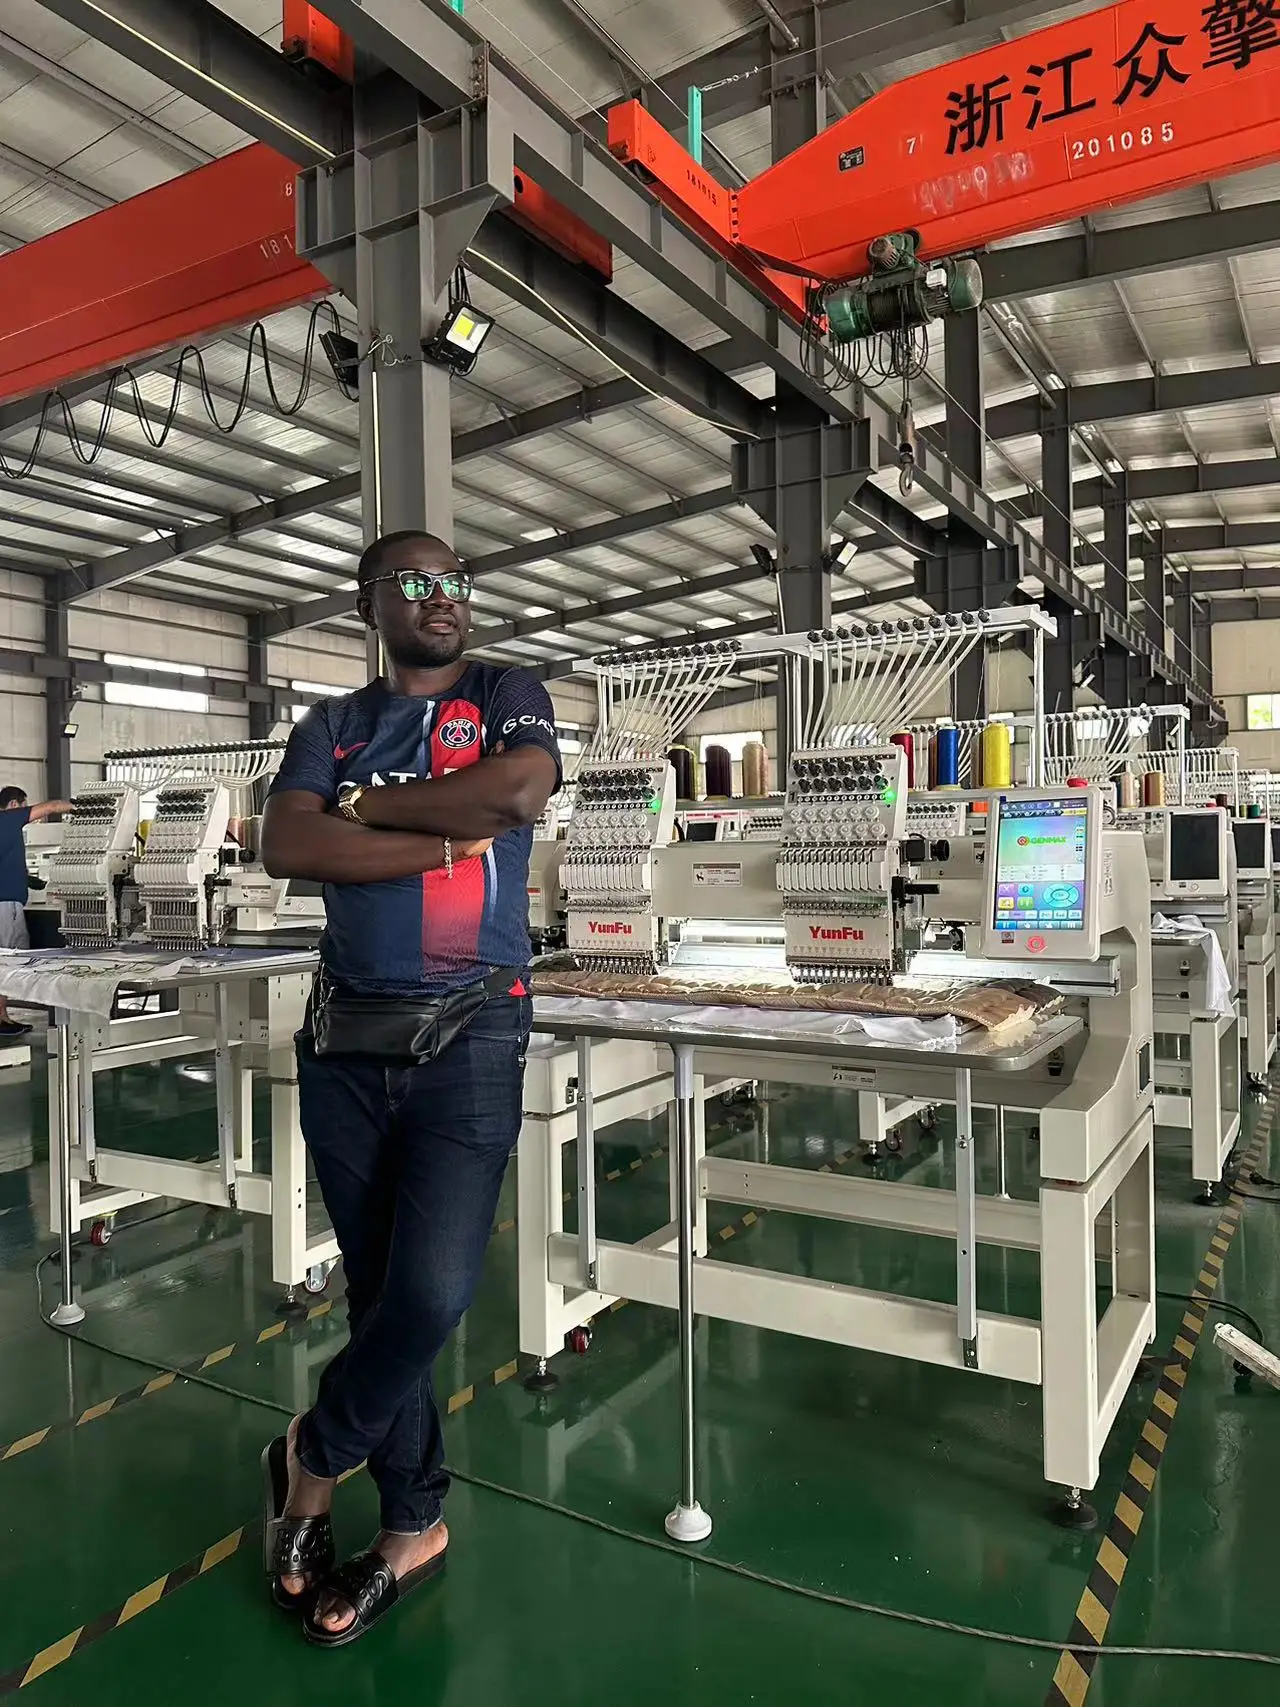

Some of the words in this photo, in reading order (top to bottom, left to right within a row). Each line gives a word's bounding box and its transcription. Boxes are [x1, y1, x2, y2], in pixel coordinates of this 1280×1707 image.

[906, 137, 917, 154] 7
[1072, 121, 1175, 160] 201085
[588, 921, 632, 935] YunFu
[809, 925, 864, 940] YunFu
